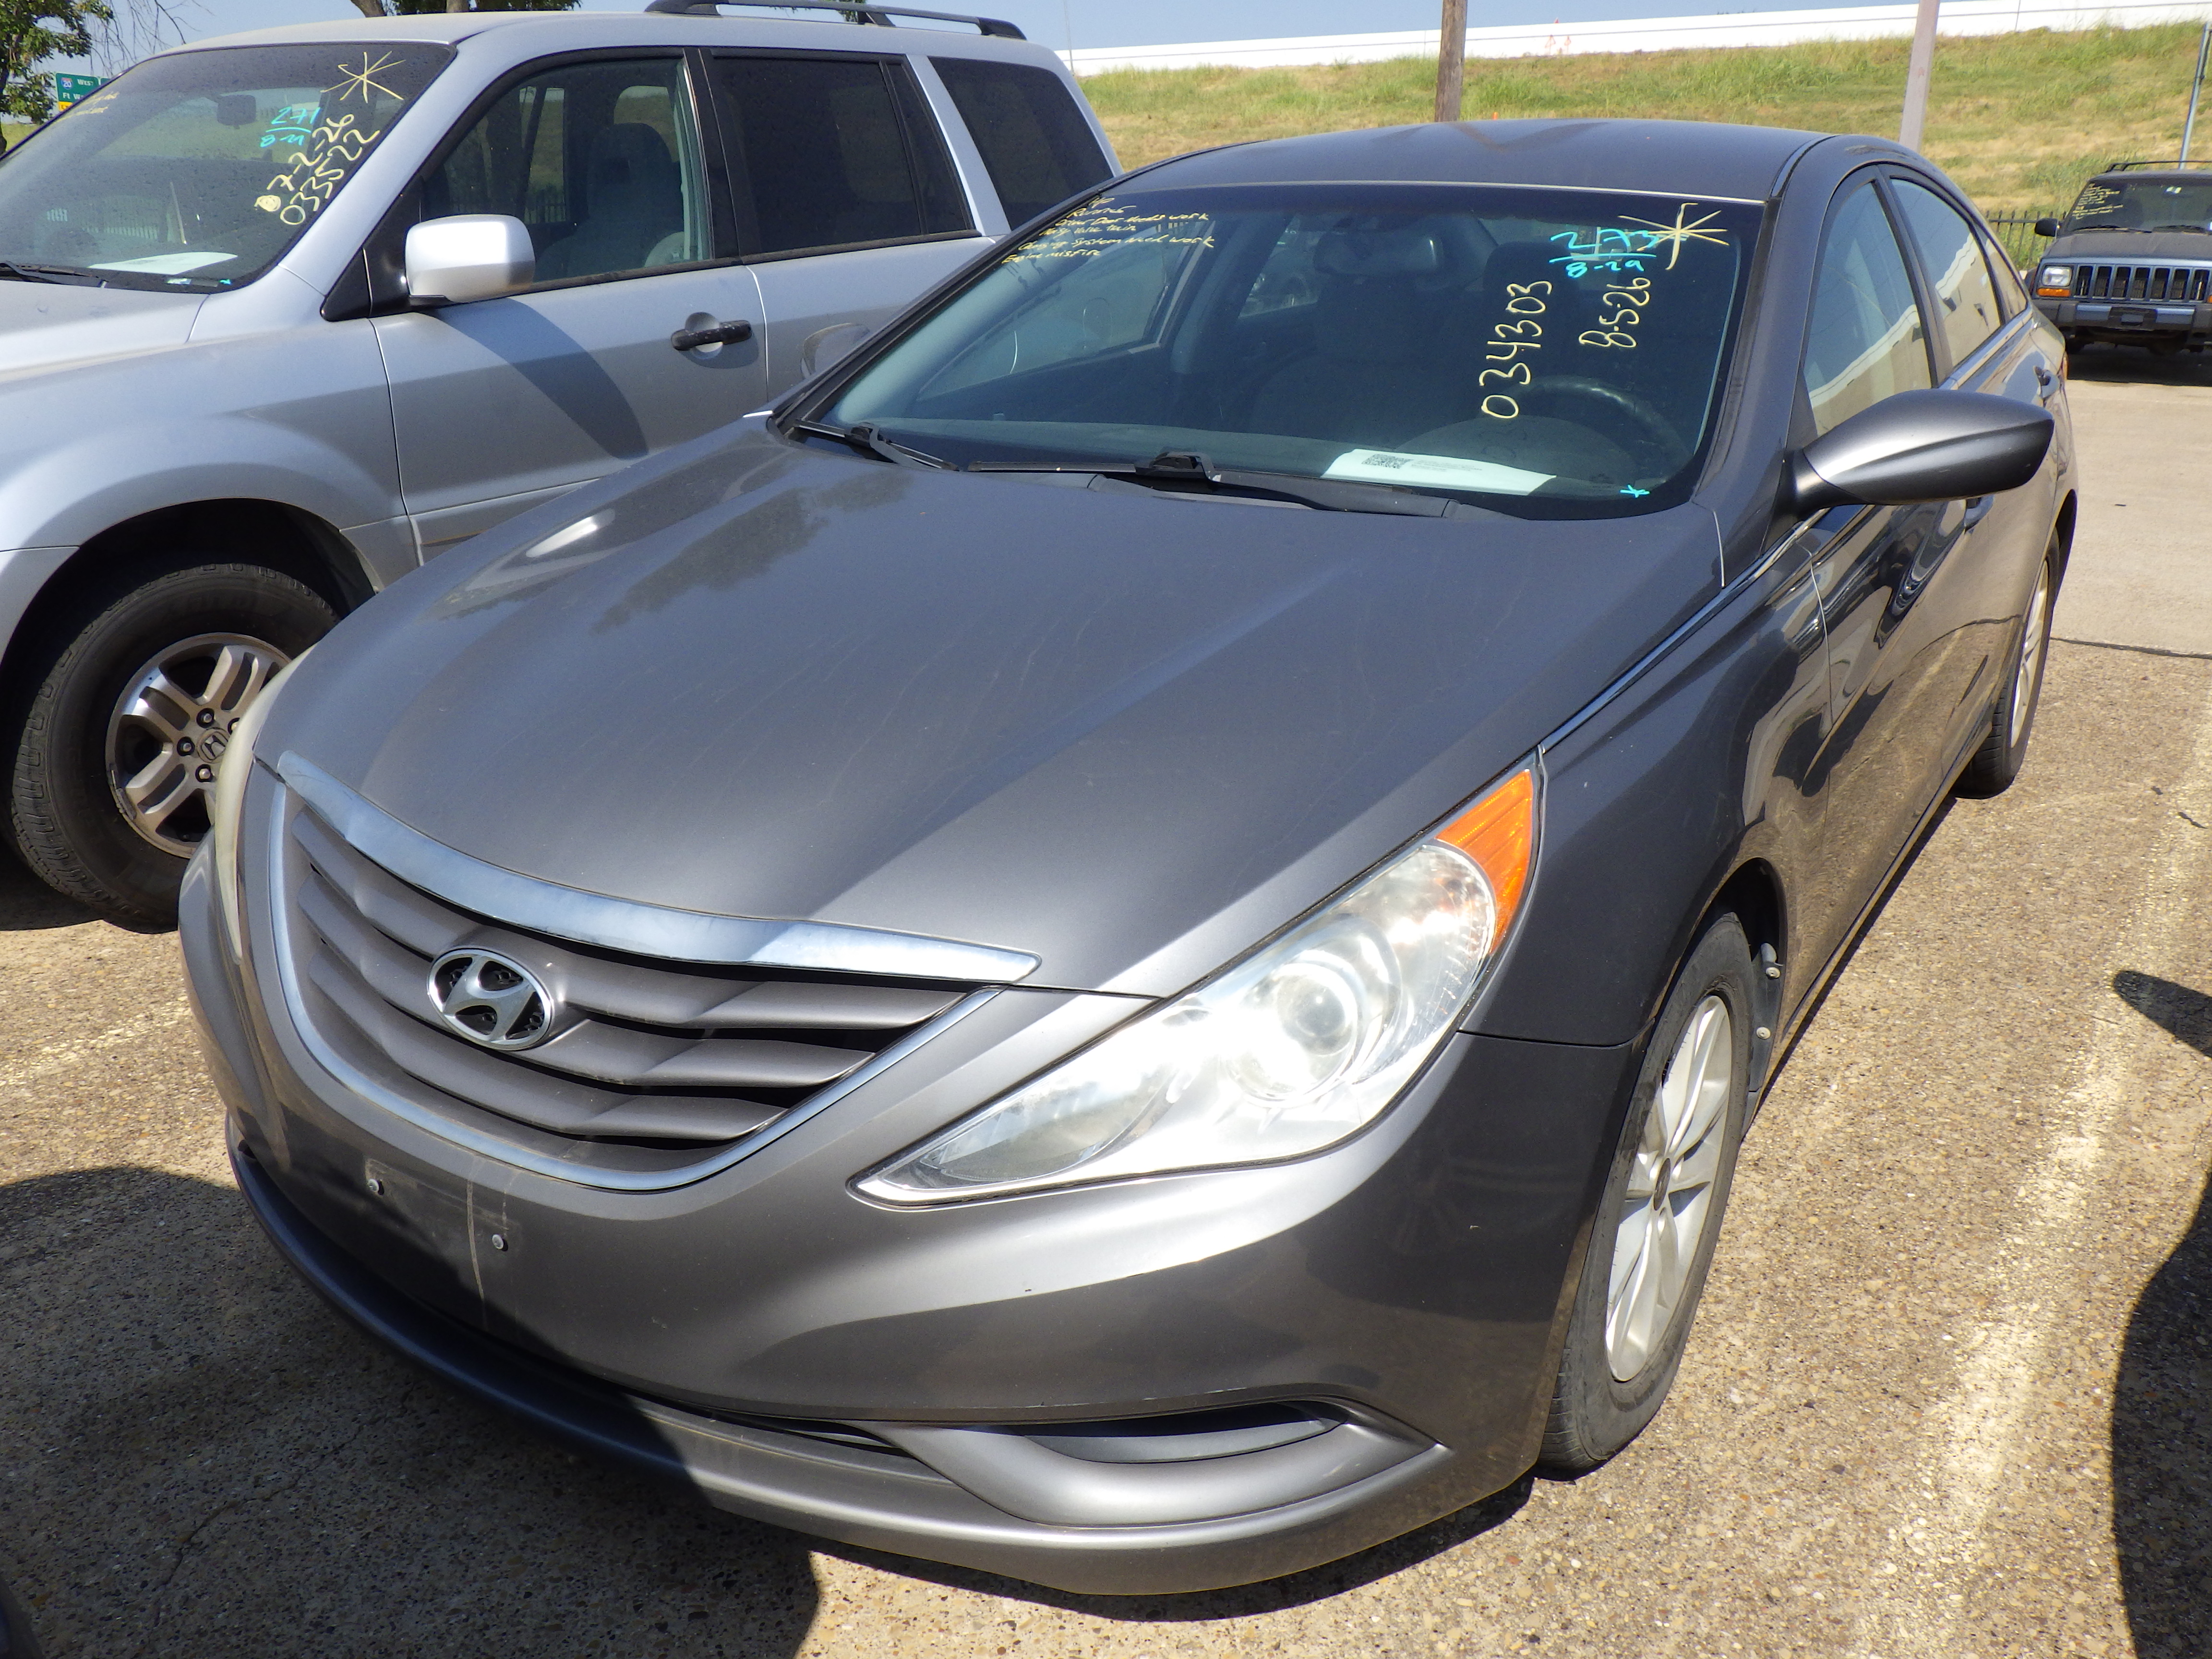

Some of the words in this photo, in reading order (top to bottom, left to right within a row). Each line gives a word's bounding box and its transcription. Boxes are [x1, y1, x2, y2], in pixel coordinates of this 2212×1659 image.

[271, 106, 321, 124] 271
[1551, 228, 1659, 249] 273
[1479, 280, 1552, 419] 034303
